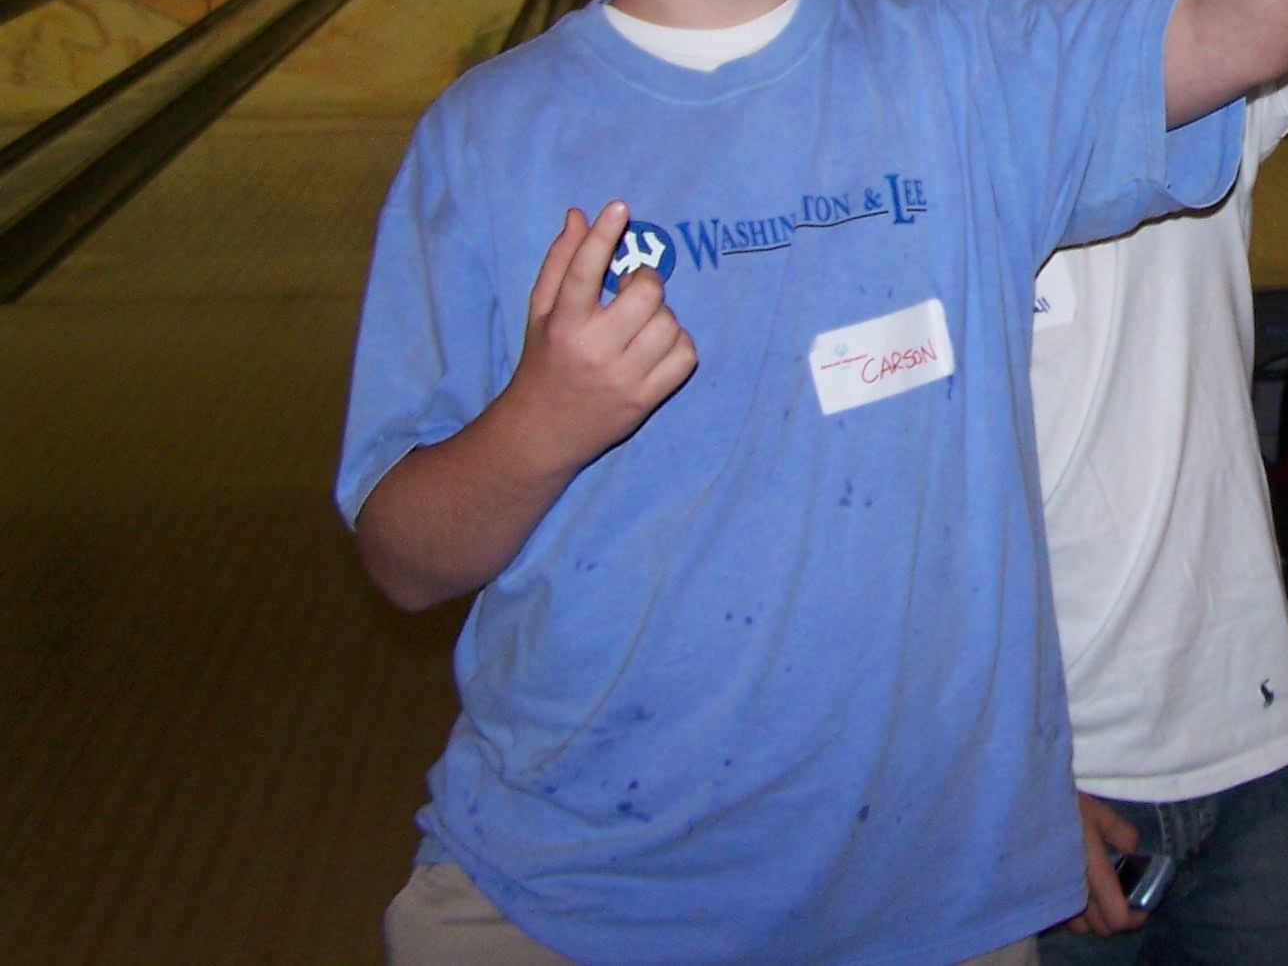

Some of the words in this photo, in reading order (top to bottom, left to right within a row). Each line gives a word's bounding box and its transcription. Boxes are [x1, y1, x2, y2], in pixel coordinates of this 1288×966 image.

[676, 192, 852, 272] WASHINTON
[863, 187, 884, 212] &
[861, 338, 938, 384] CARSON
